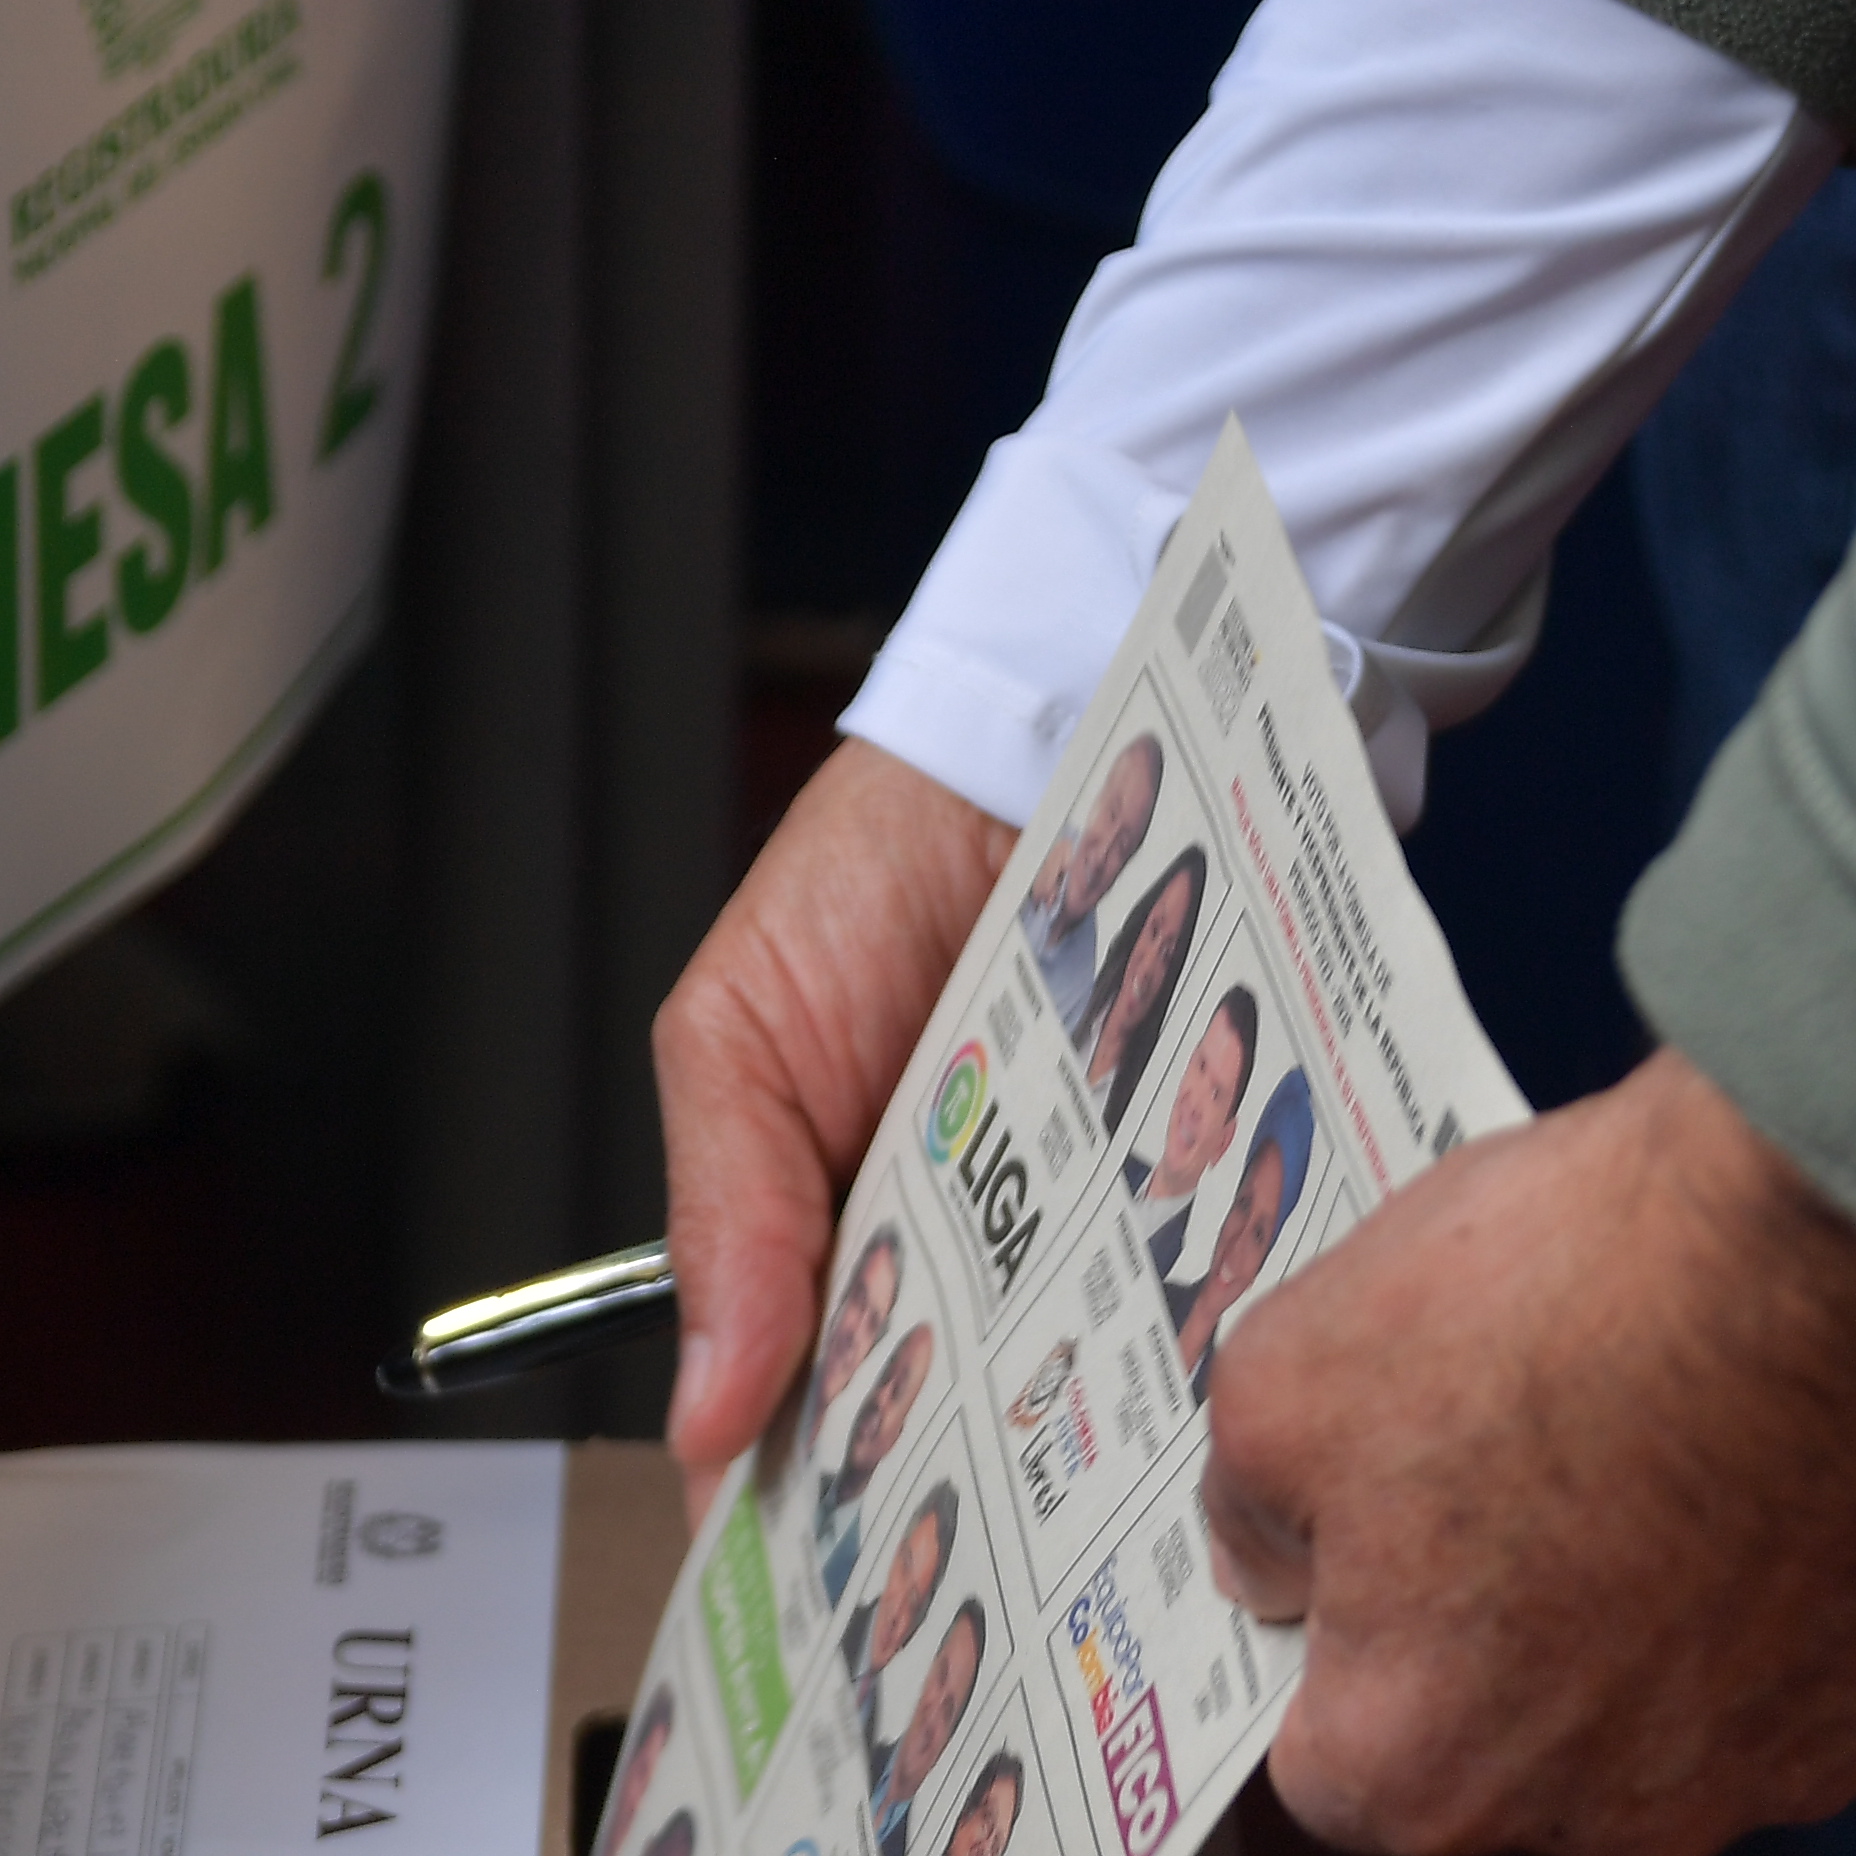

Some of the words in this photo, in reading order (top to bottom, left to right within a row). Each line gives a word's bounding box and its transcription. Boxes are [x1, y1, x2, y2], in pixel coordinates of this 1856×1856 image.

[315, 169, 391, 468] 2
[957, 1100, 1043, 1296] LIGA
[311, 1627, 415, 1839] URNA
